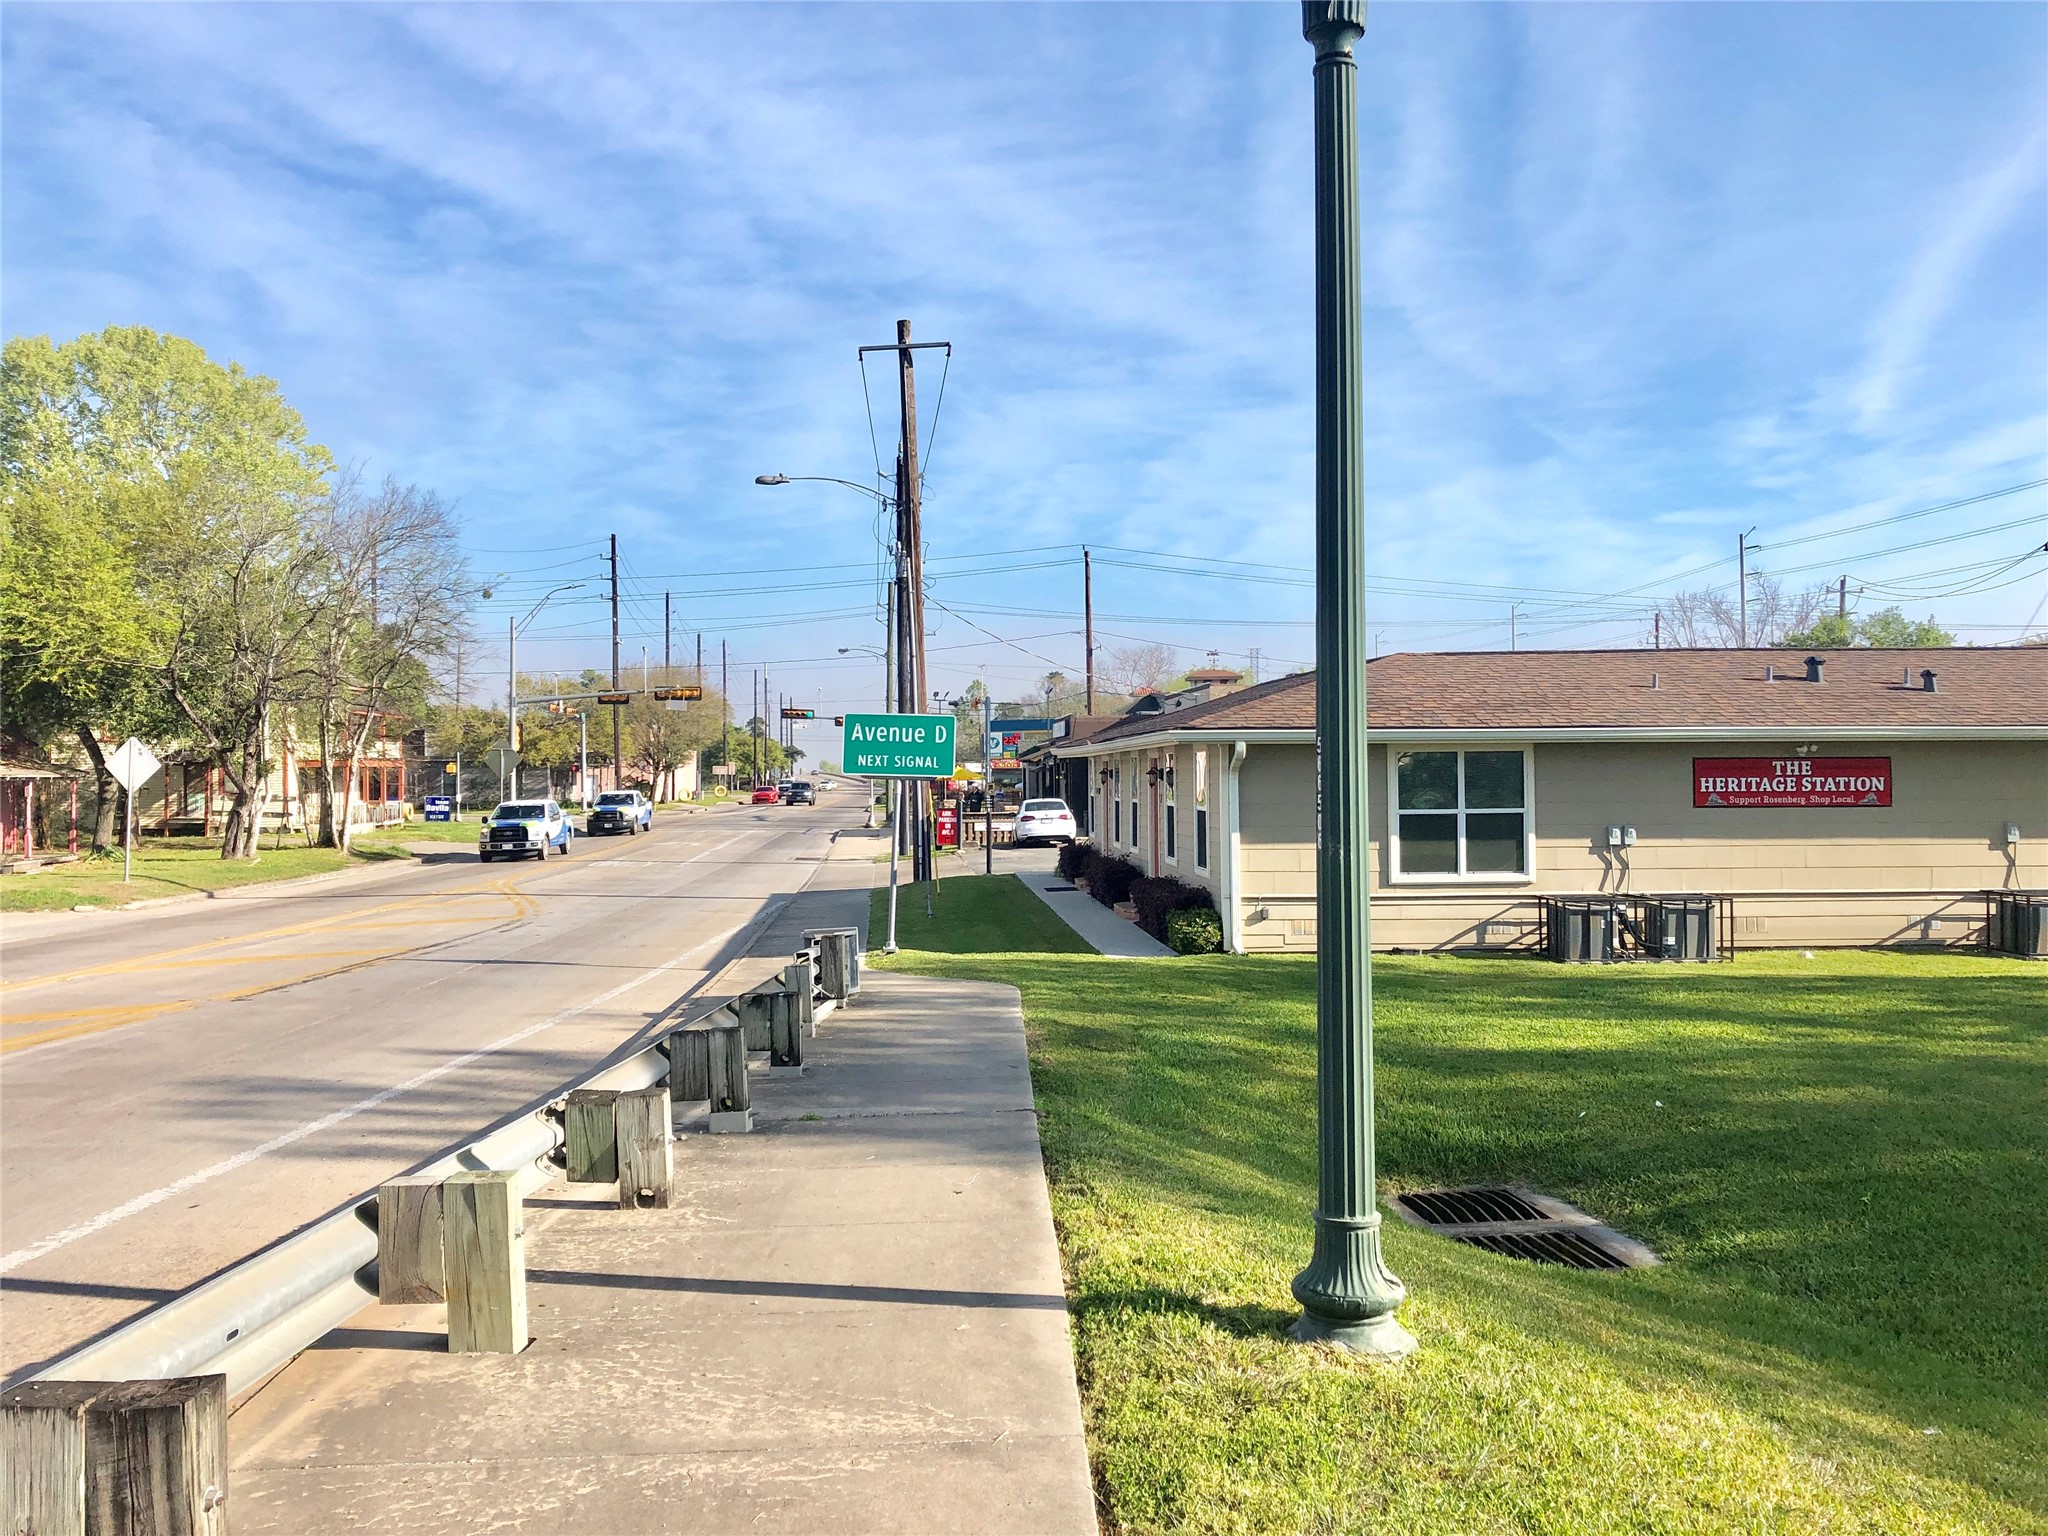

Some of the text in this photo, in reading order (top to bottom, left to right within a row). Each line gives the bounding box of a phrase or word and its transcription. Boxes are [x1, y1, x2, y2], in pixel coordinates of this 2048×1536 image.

[851, 723, 947, 744] Avenue D
[857, 754, 939, 769] NEXT SIGNAL
[1772, 761, 1812, 776] THE
[1699, 776, 1885, 793] HERITAGE STATION
[1729, 795, 1857, 805] Support Rosenberg. Shop Local.
